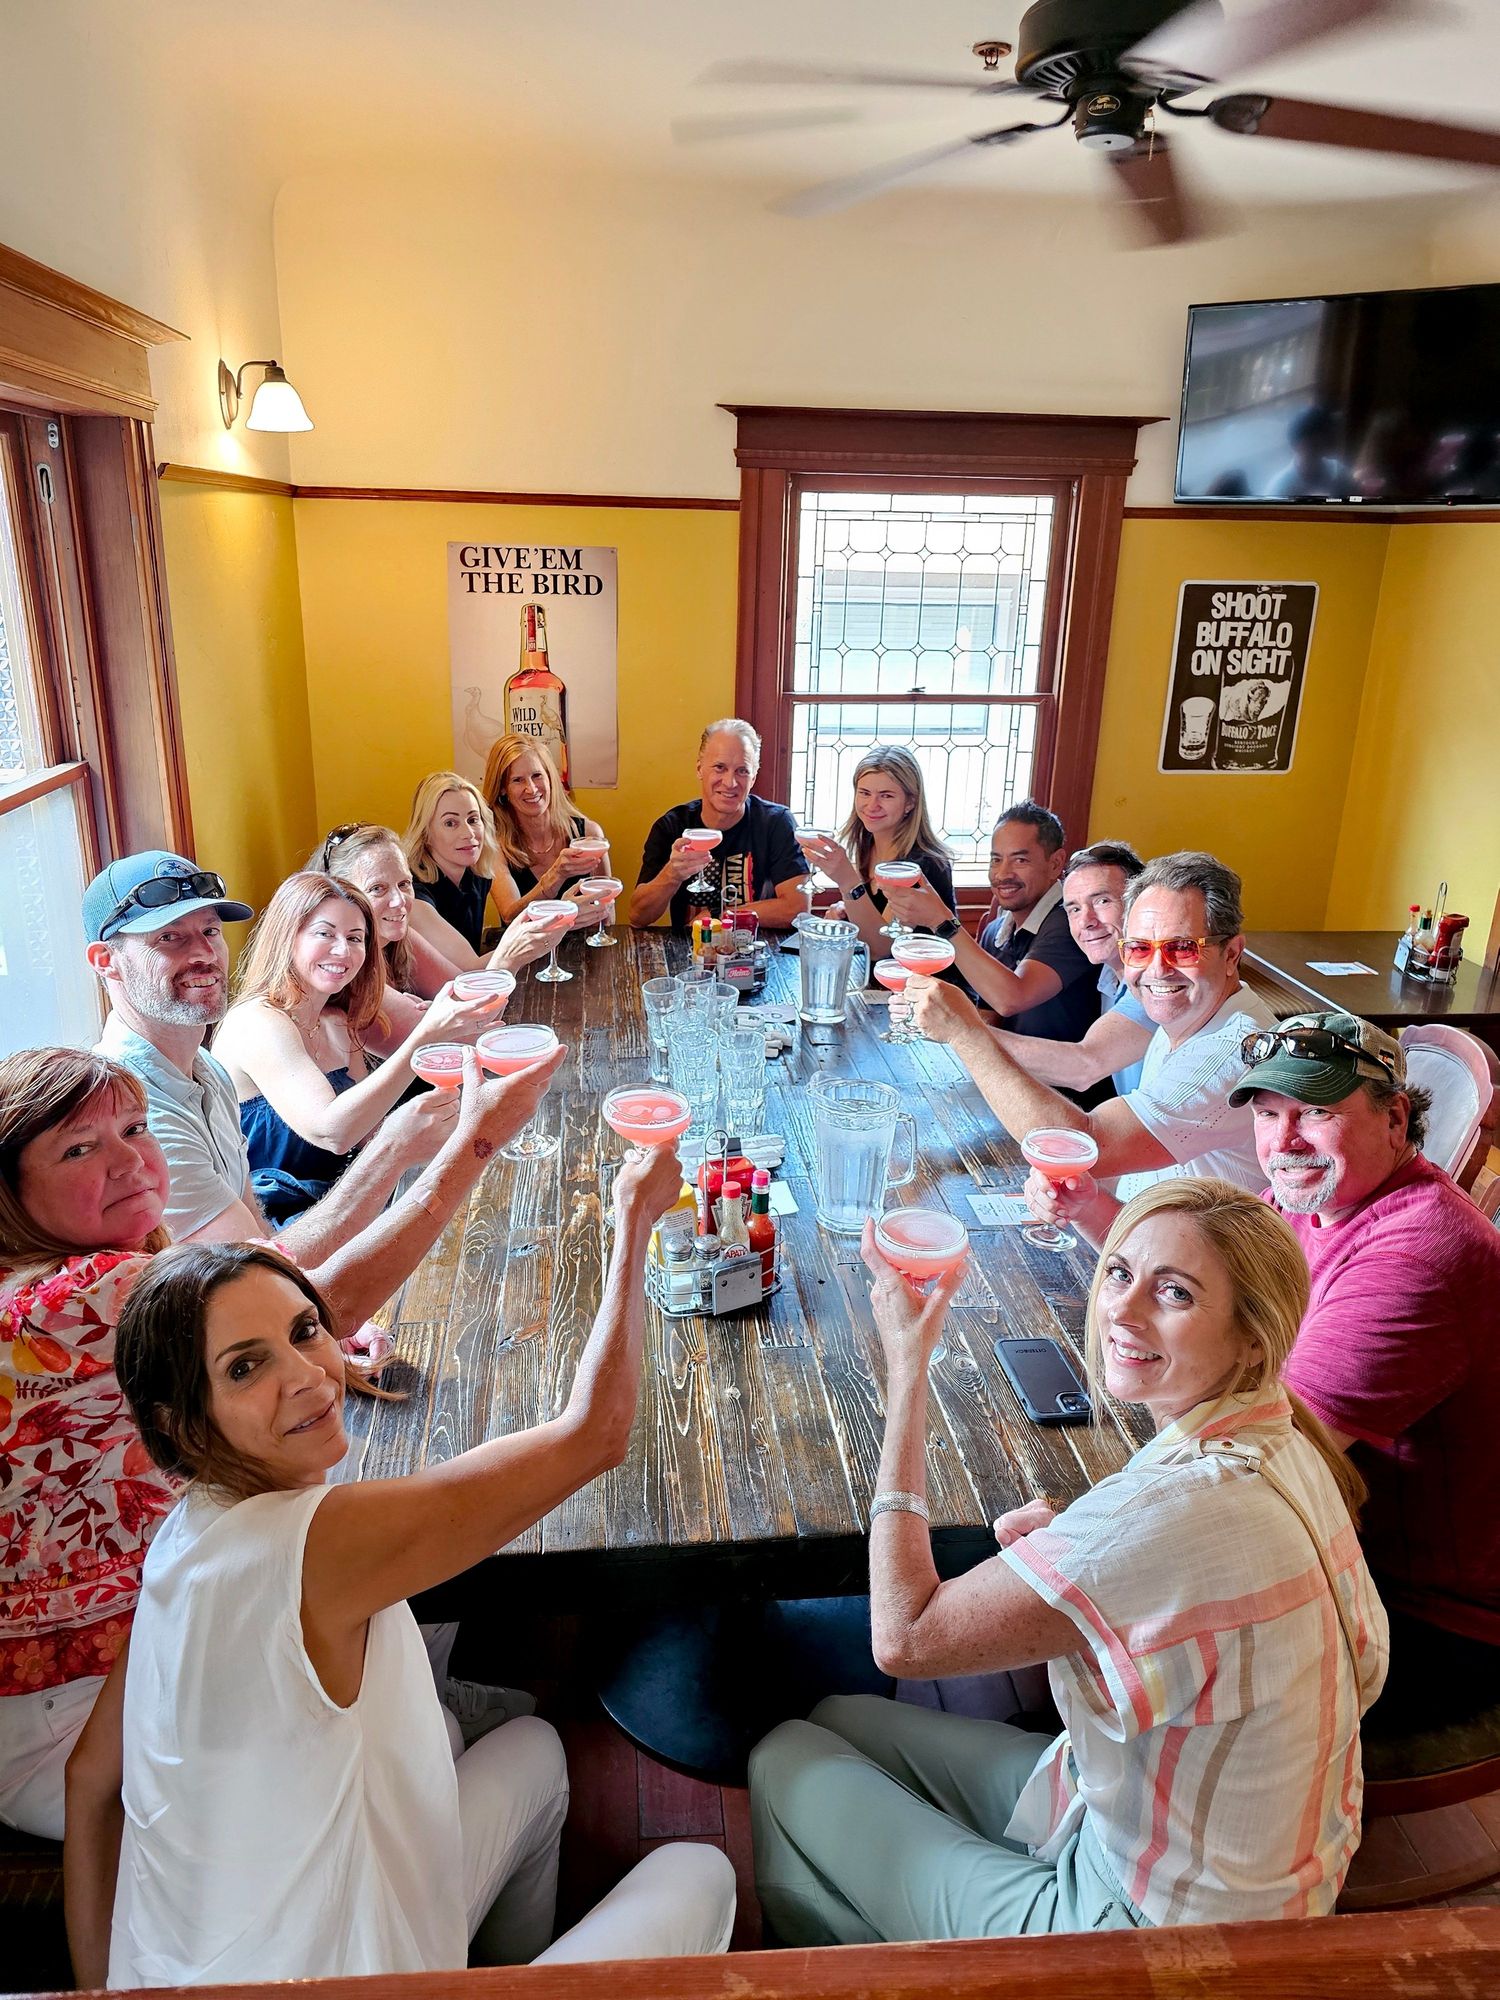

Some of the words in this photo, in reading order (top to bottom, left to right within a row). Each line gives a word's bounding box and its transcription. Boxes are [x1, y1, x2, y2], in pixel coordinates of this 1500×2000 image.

[461, 572, 523, 593] THE
[532, 573, 603, 595] BIRD
[1211, 592, 1287, 620] SHOOT
[1195, 621, 1293, 648] BUFFALO
[1191, 650, 1222, 676] ON
[1226, 649, 1292, 676] SIGHT
[512, 707, 537, 721] WILD
